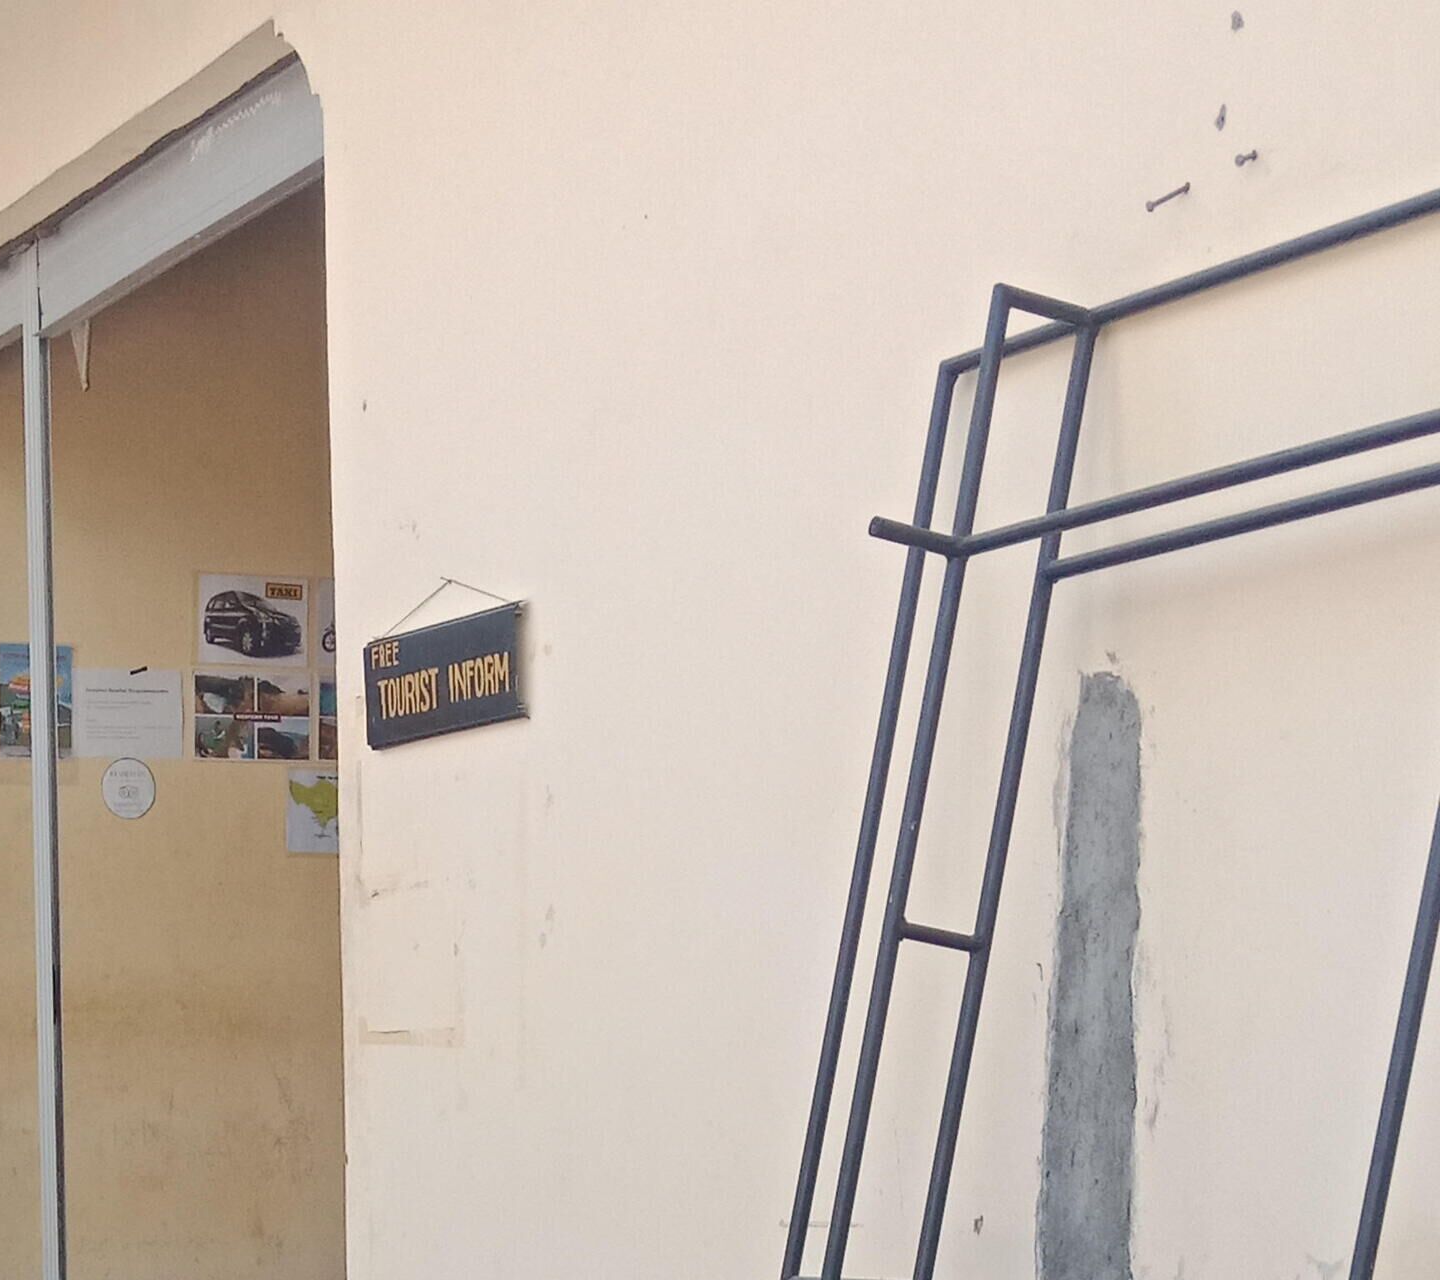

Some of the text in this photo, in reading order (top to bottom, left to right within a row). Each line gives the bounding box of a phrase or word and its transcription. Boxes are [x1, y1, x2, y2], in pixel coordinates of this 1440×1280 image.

[371, 641, 400, 670] FREE
[377, 651, 510, 720] TOURIST INFORM
